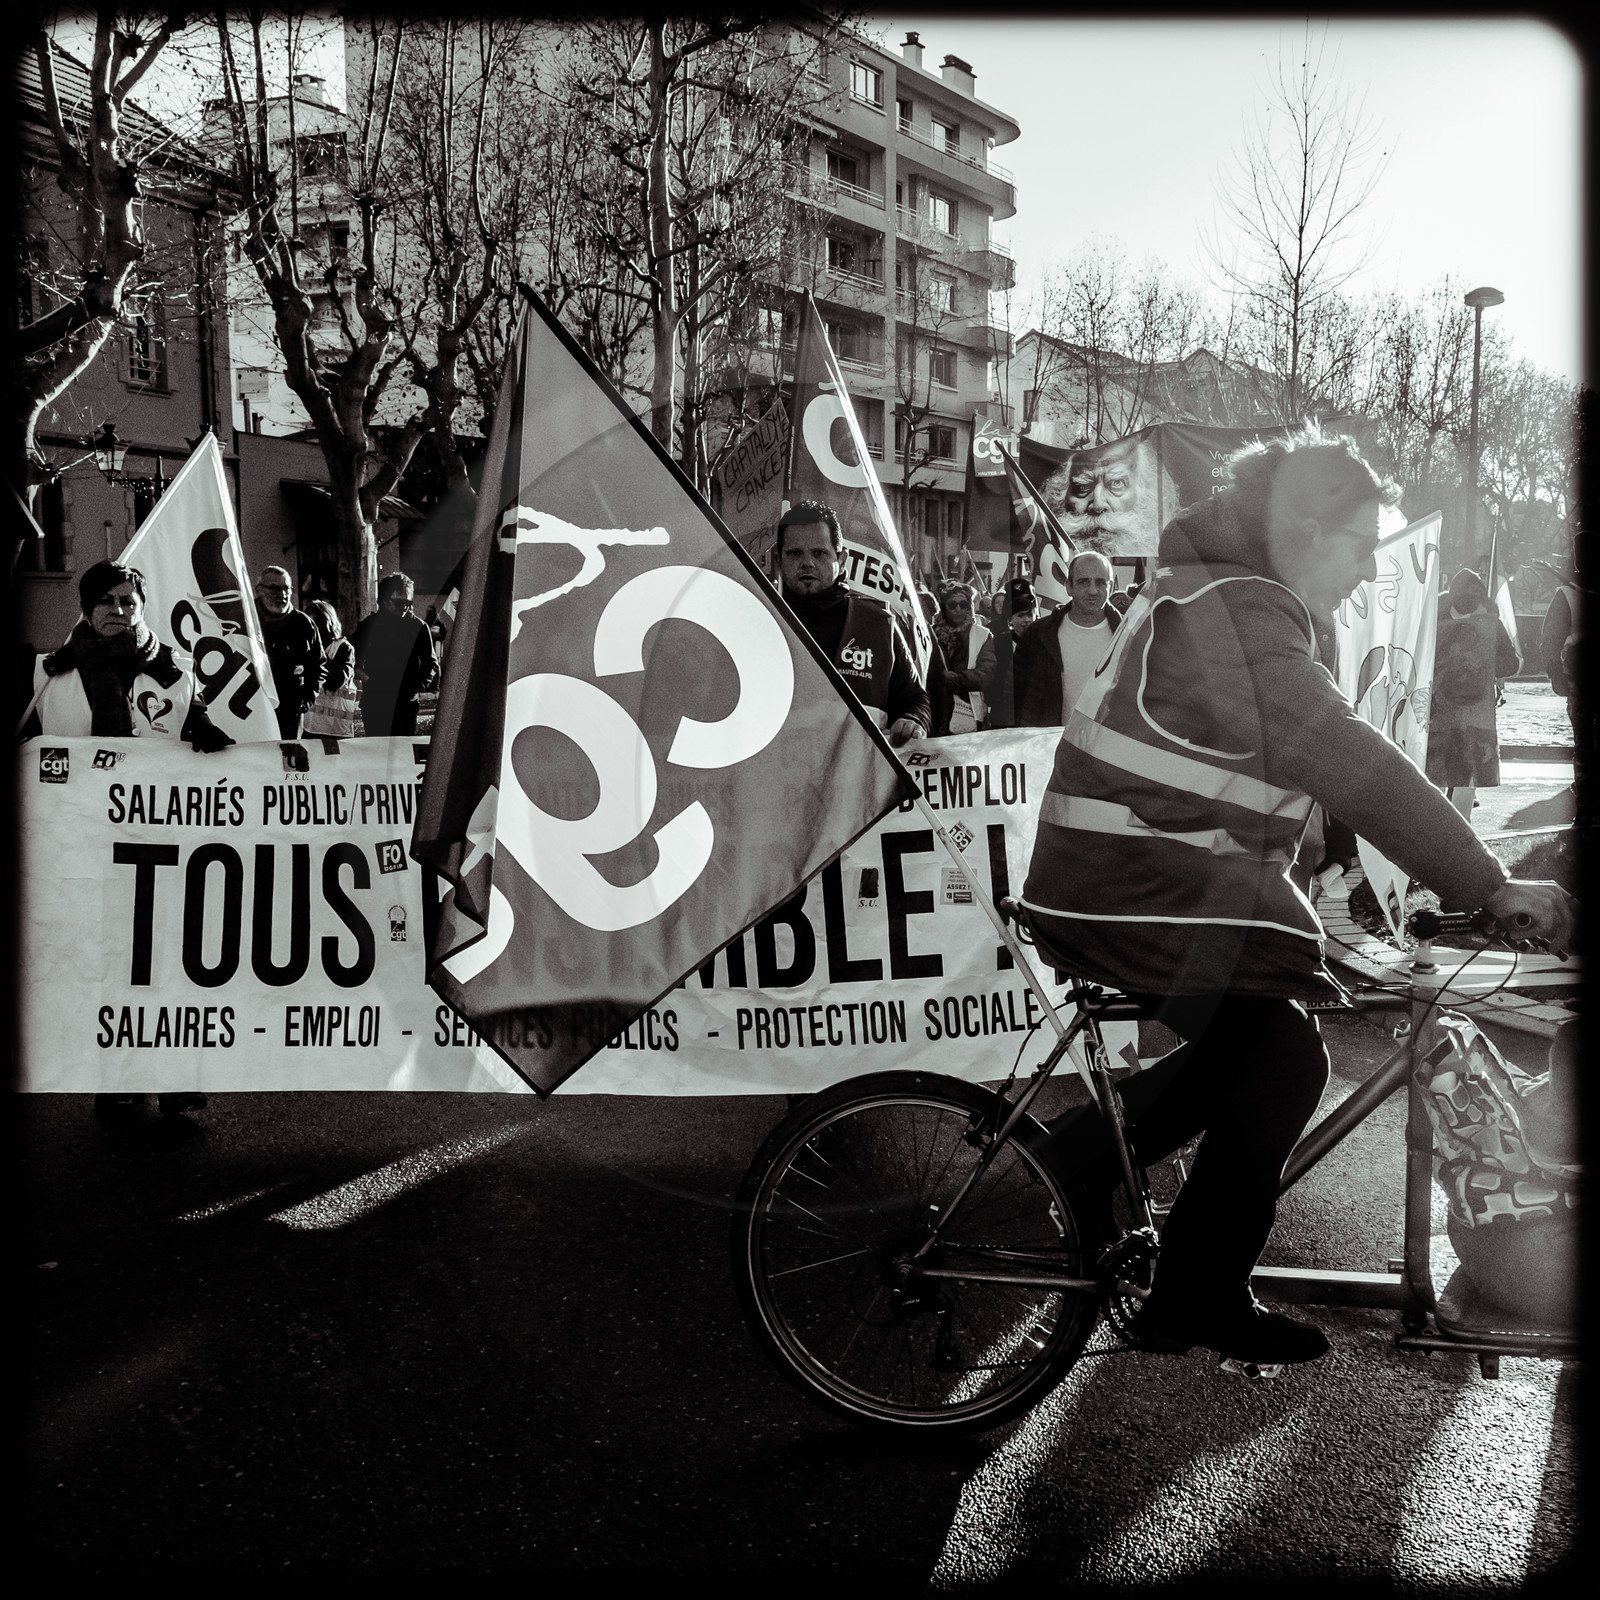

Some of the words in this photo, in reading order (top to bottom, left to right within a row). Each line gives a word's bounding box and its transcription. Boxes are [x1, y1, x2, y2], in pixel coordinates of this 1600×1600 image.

[973, 432, 1020, 464] cgt
[170, 599, 262, 721] cgt
[840, 648, 874, 671] cgt
[40, 757, 69, 775] cgt
[108, 776, 245, 827] SALARIÉS
[382, 844, 402, 866] FO
[113, 842, 378, 989] TOUS
[391, 929, 408, 941] cgt
[96, 1004, 236, 1049] SALAIRES
[284, 1004, 381, 1048] EMPLOI
[737, 998, 907, 1050] PROTECTION
[924, 987, 1042, 1042] SOCIALE
